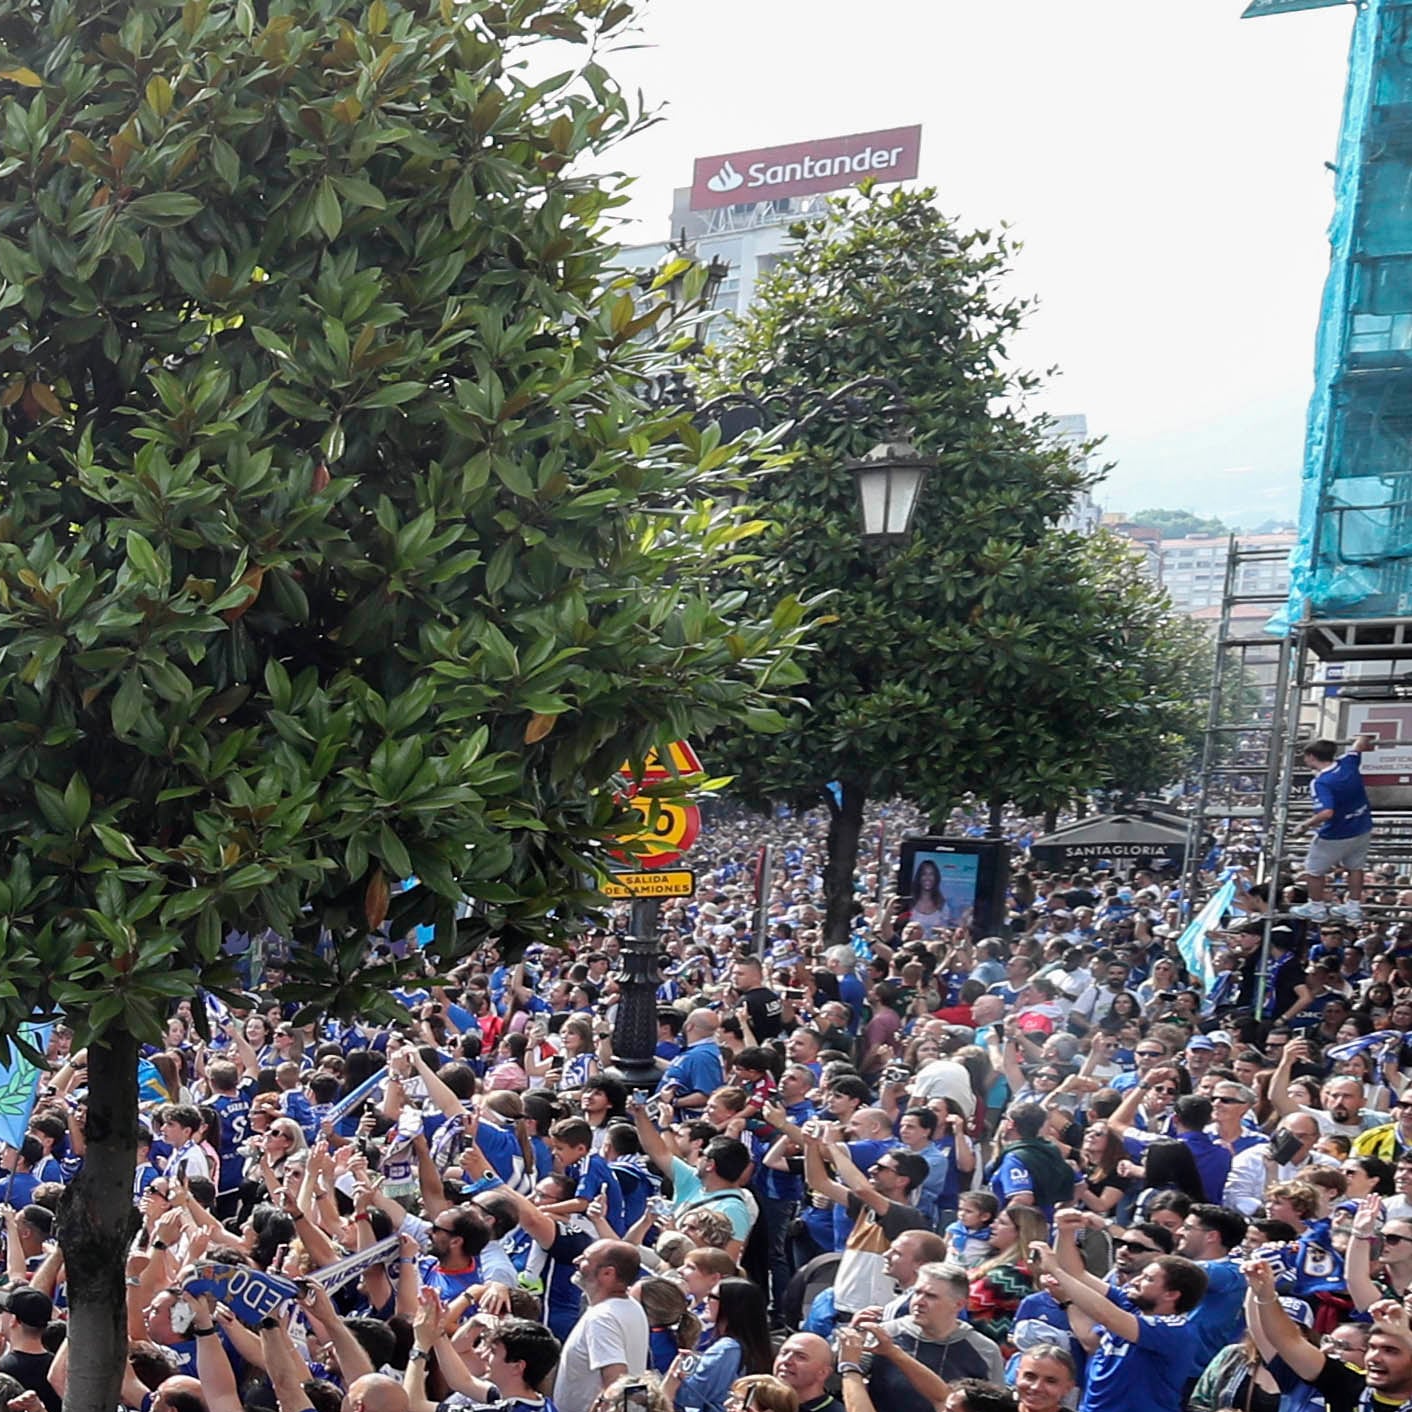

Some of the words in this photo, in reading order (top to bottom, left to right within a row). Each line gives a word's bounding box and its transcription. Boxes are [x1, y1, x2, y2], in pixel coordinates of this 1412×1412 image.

[747, 146, 904, 189] Santander
[1065, 844, 1167, 858] SANTAGLORIA
[625, 875, 669, 885] SALIDA
[604, 887, 621, 896] DE
[623, 884, 690, 895] CAMIONES
[228, 1268, 283, 1318] EDO
